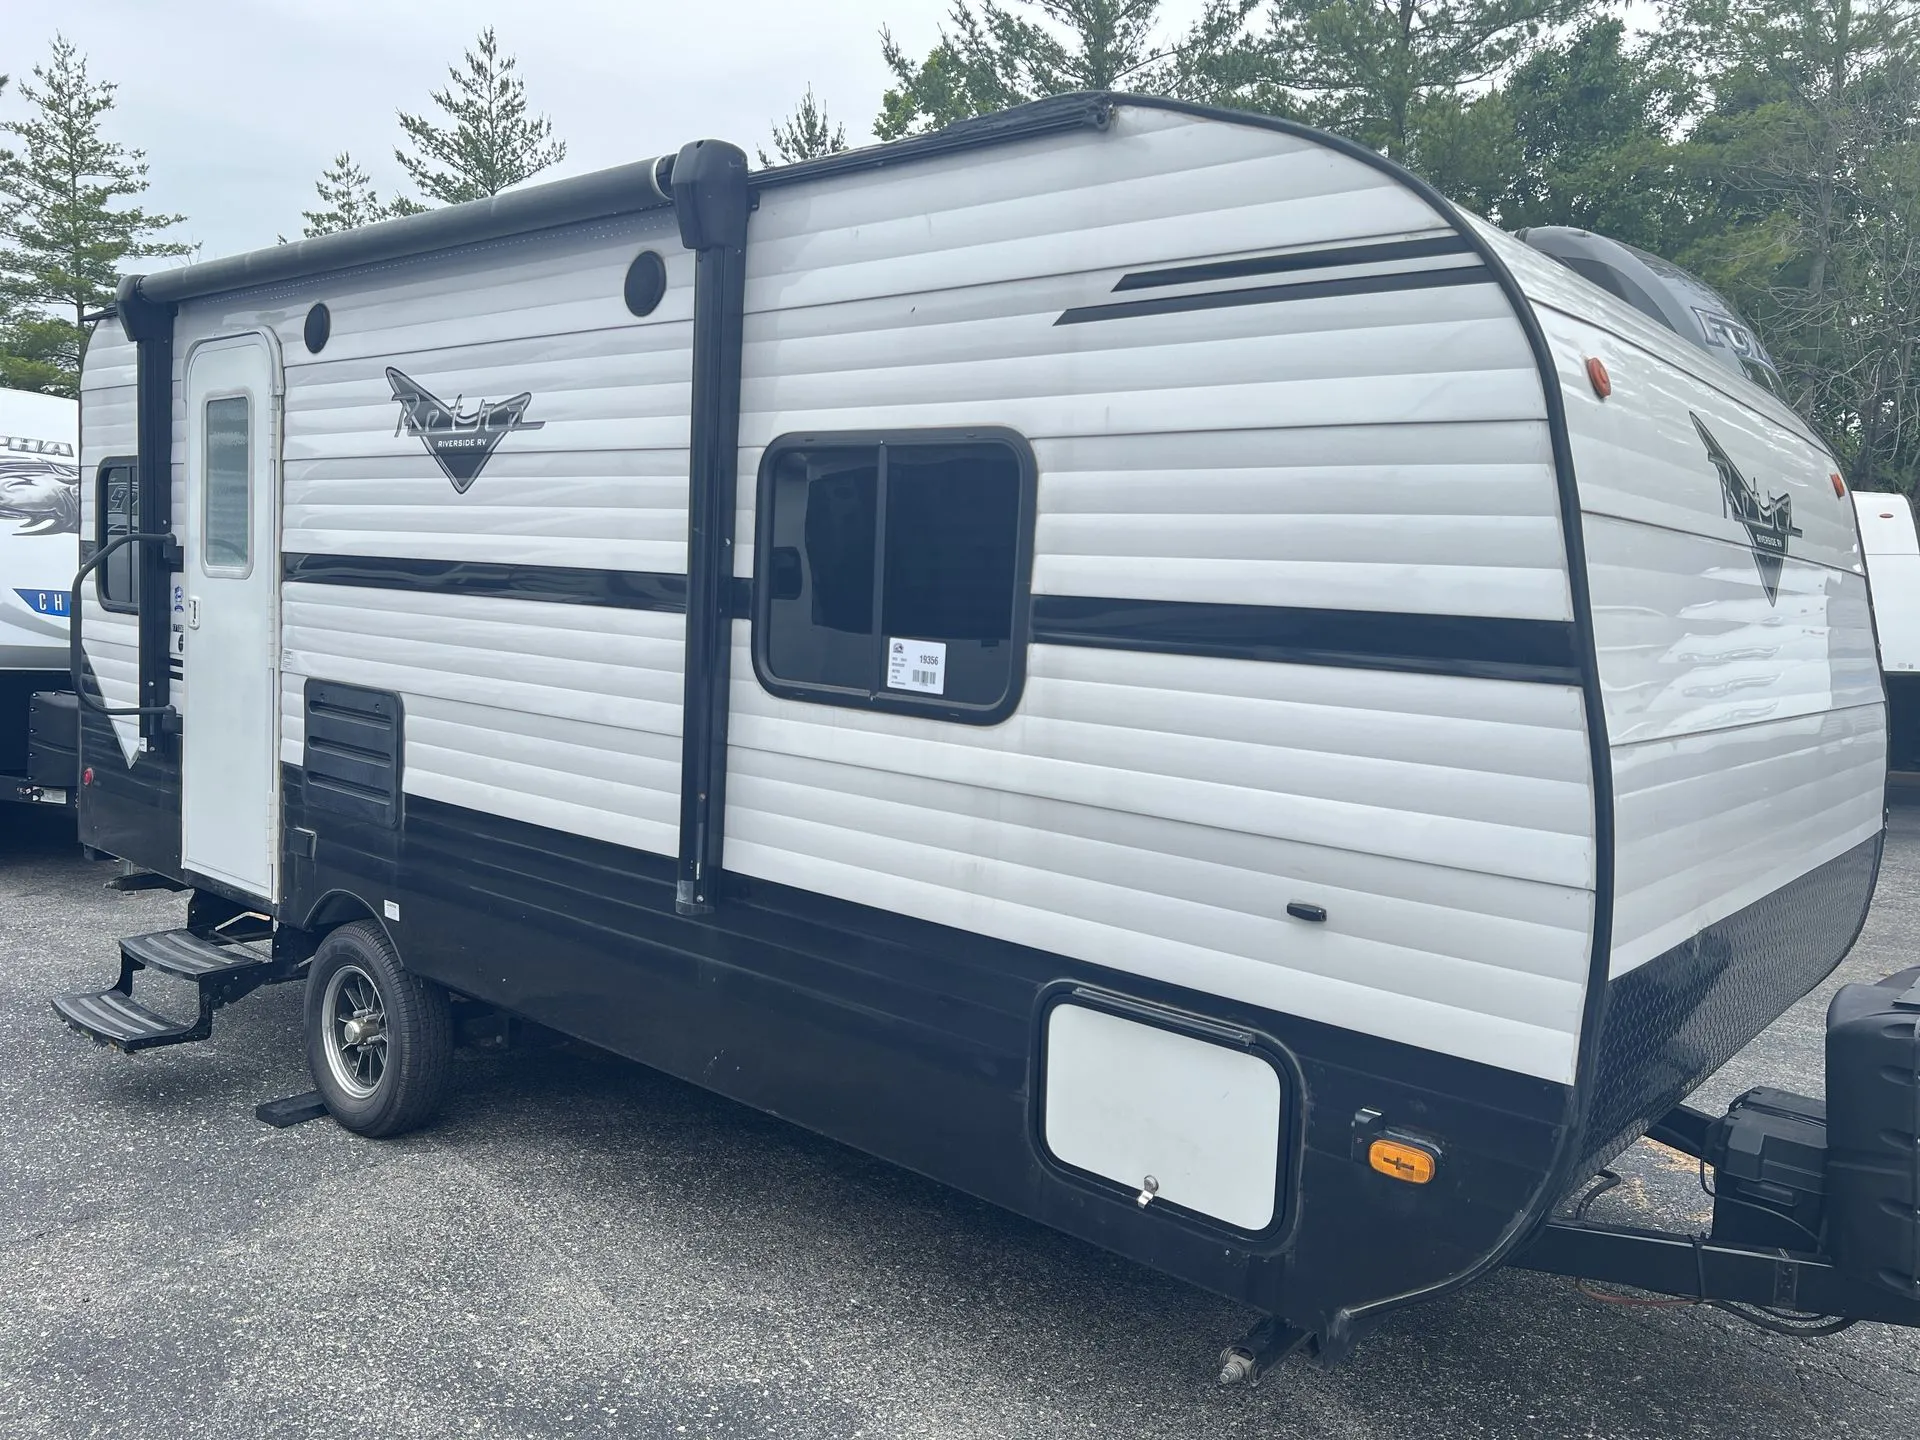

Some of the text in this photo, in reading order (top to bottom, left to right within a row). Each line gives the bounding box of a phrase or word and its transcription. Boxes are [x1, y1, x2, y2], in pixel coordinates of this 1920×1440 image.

[437, 438, 487, 448] RIVERSIDE RV
[919, 655, 939, 665] 19356
